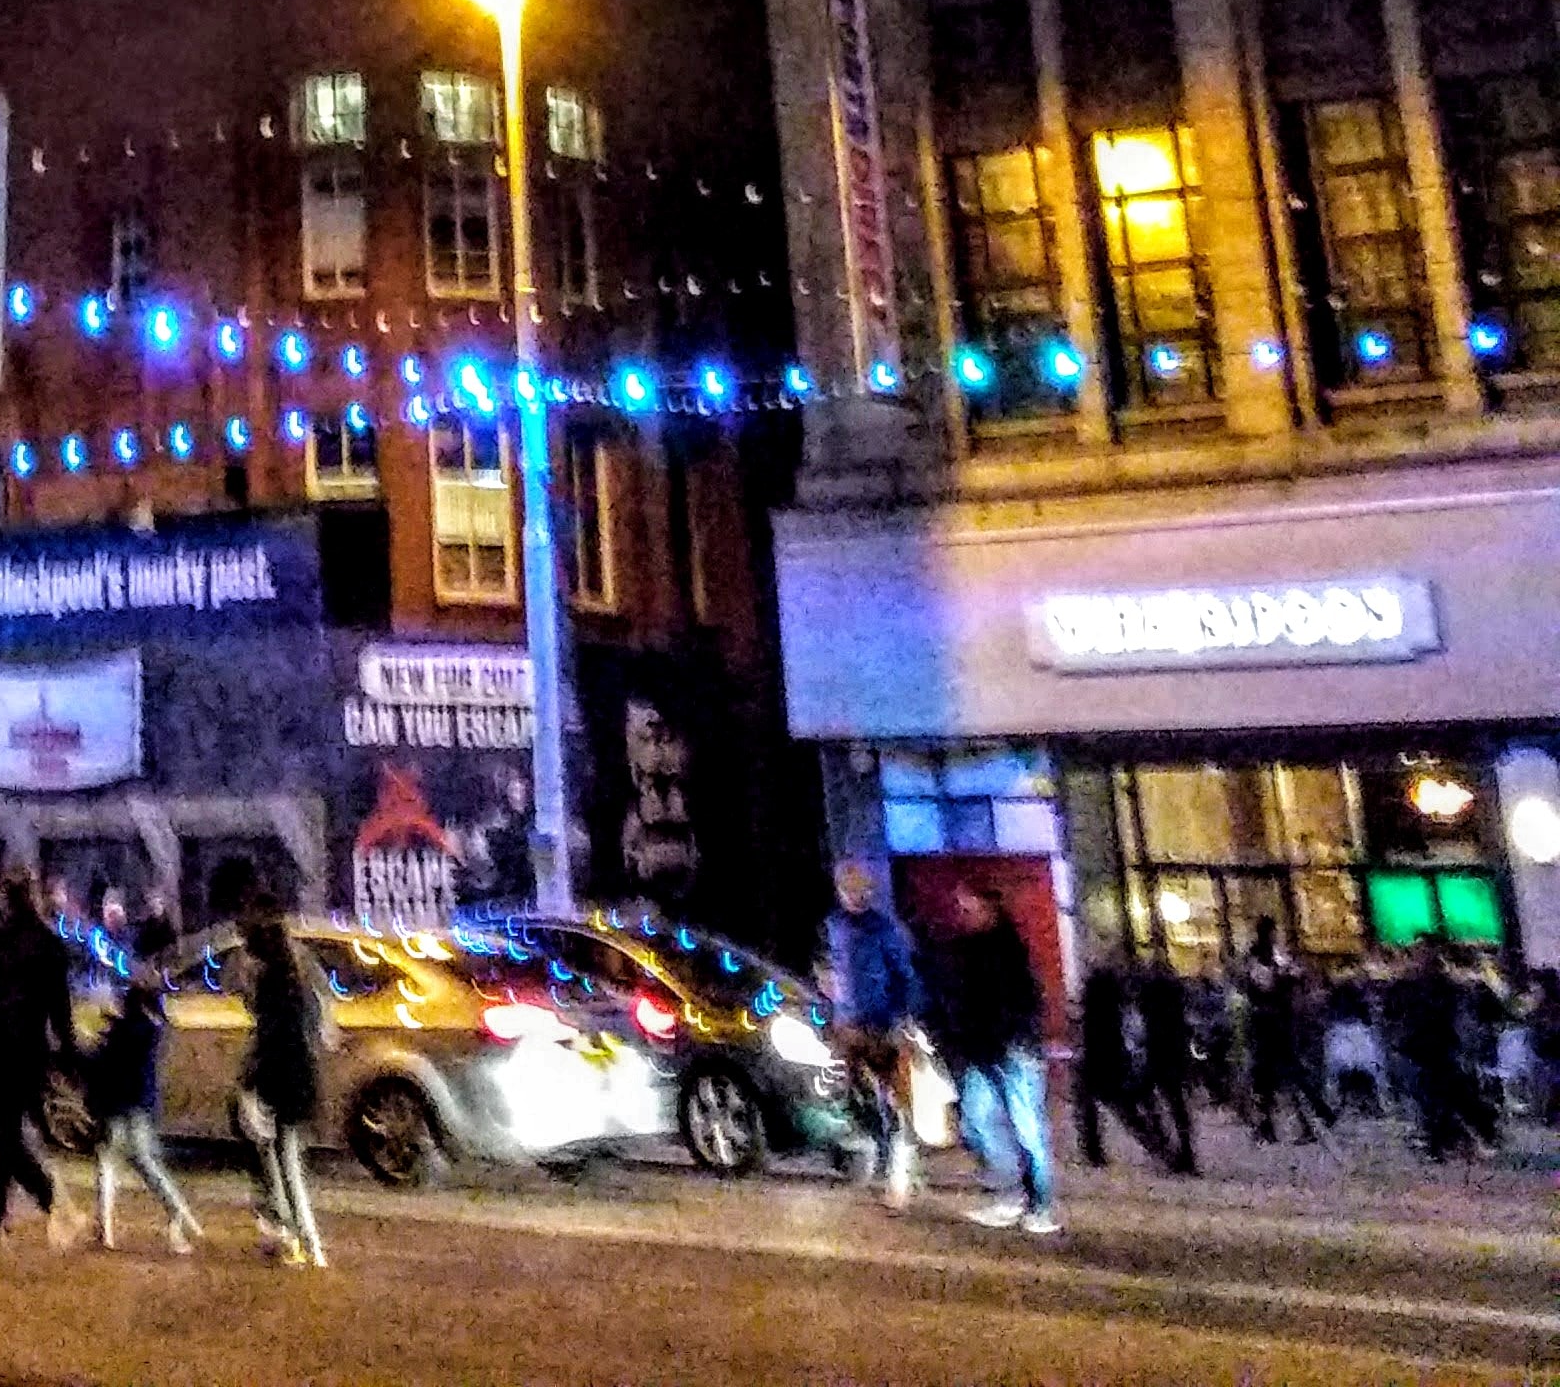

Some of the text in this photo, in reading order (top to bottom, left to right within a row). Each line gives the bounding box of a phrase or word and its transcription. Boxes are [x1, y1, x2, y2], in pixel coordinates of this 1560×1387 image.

[344, 699, 534, 750] CAN YOU ESCAP
